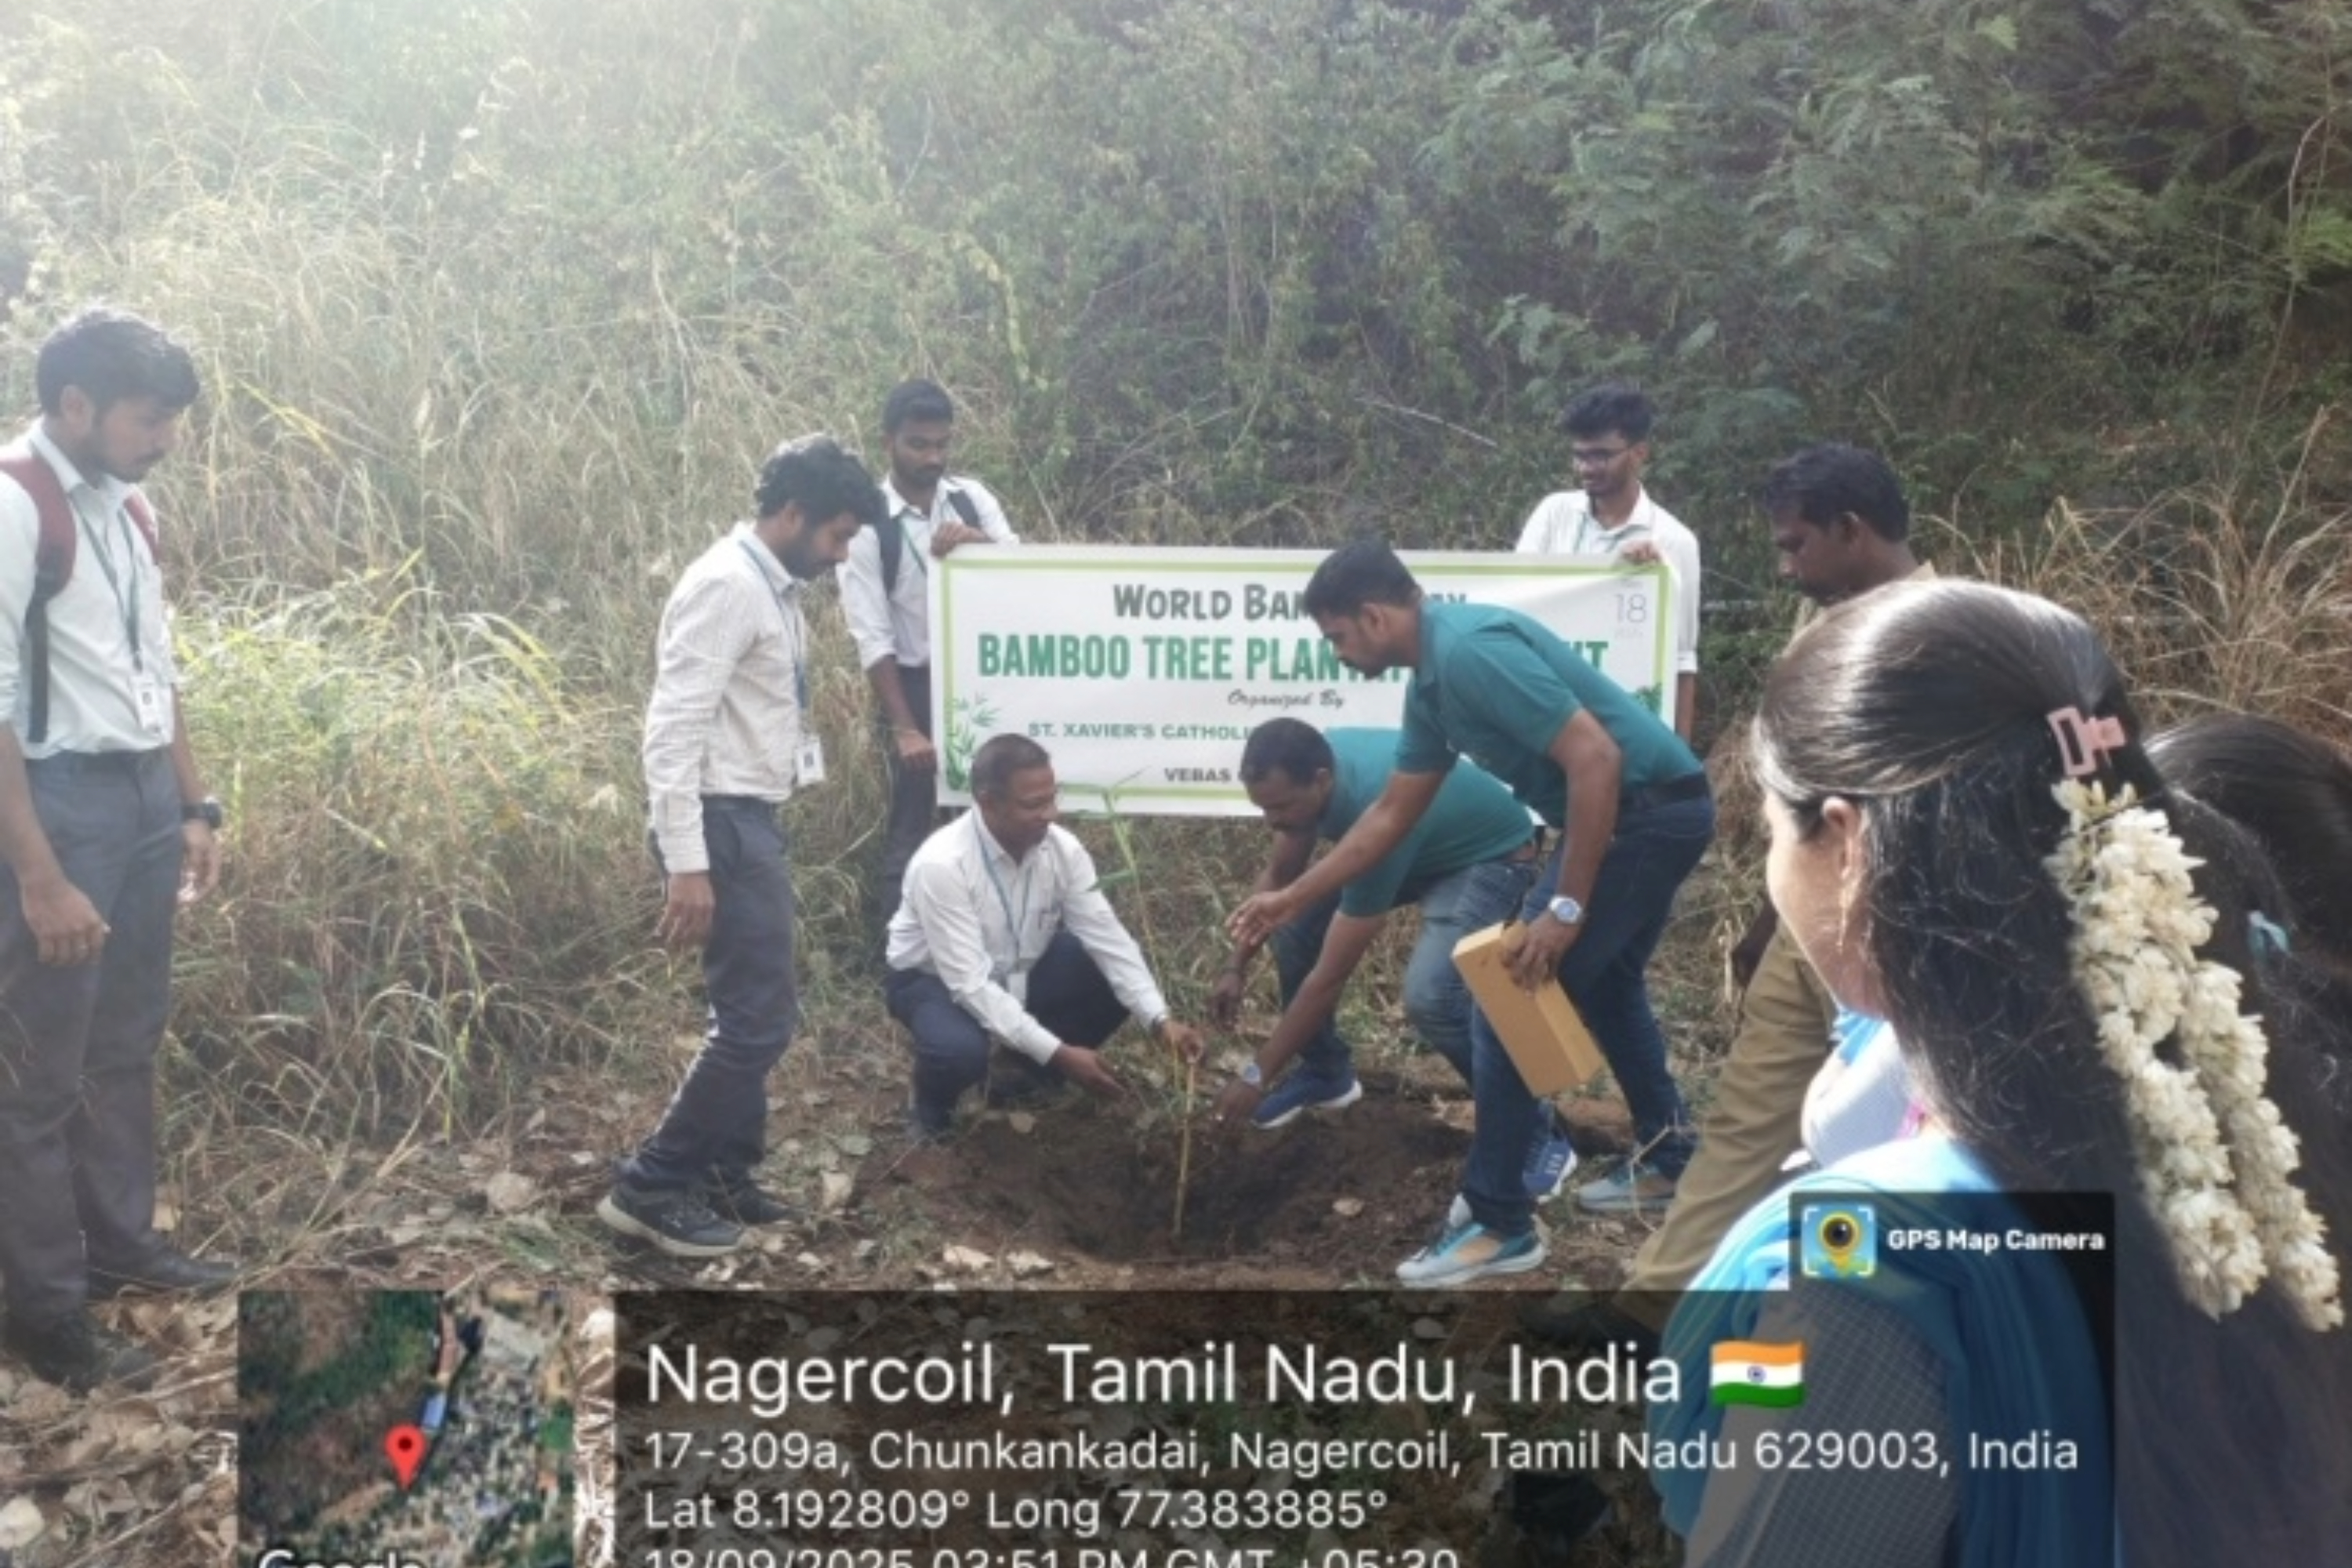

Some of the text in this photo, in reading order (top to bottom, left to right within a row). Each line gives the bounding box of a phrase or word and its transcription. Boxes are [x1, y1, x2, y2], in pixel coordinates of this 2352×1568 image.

[1112, 584, 1232, 620] WORLD
[1613, 593, 1647, 623] 18
[978, 633, 1131, 678] BAMBOO
[1142, 635, 1232, 681] TREE
[1227, 688, 1345, 709] Organized By
[1028, 723, 1250, 741] ST. XAVIER'S CATHOLI
[1164, 768, 1232, 782] VEBAS
